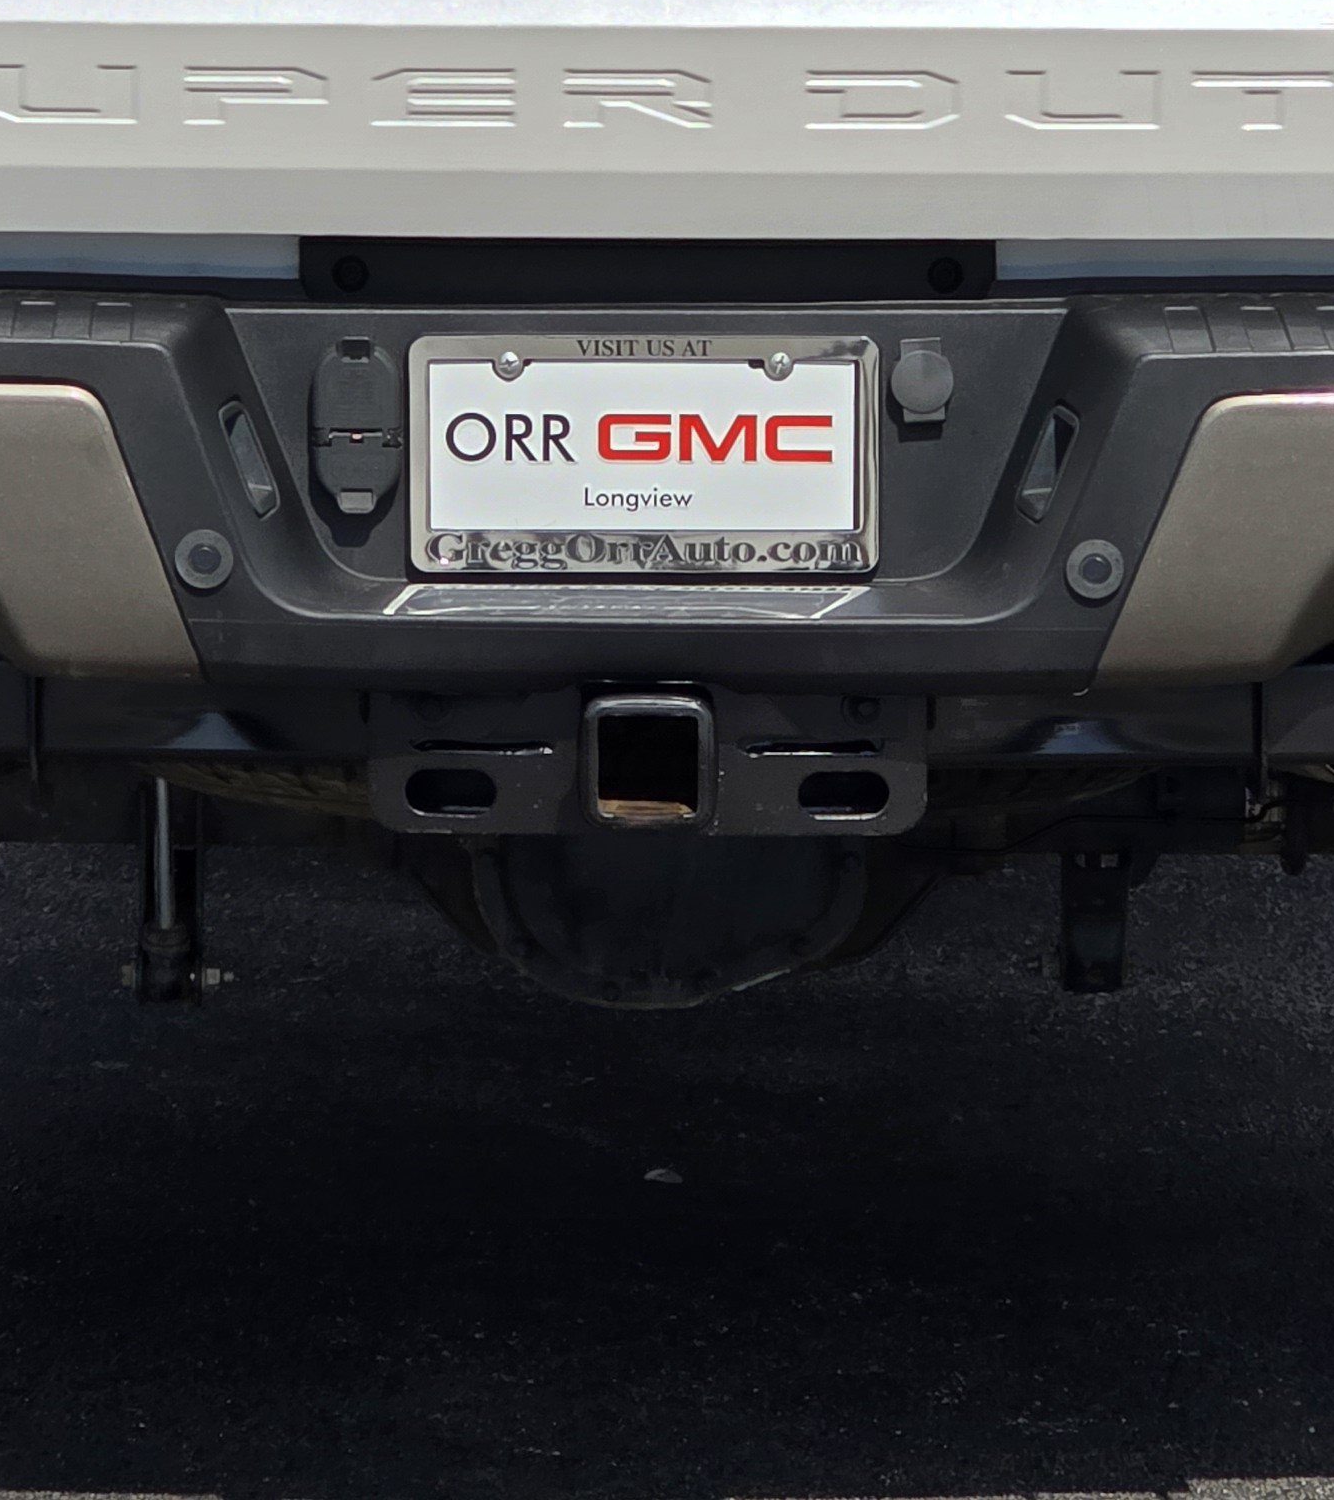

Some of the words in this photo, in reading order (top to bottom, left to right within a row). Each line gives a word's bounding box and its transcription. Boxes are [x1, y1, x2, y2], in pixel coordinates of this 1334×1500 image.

[576, 339, 641, 358] VISIT
[645, 339, 675, 358] US
[680, 339, 713, 358] AT
[445, 412, 576, 463] ORR
[597, 413, 834, 463] GMC
[584, 487, 693, 512] Longview
[427, 532, 864, 570] GreggOrrAuto.com
